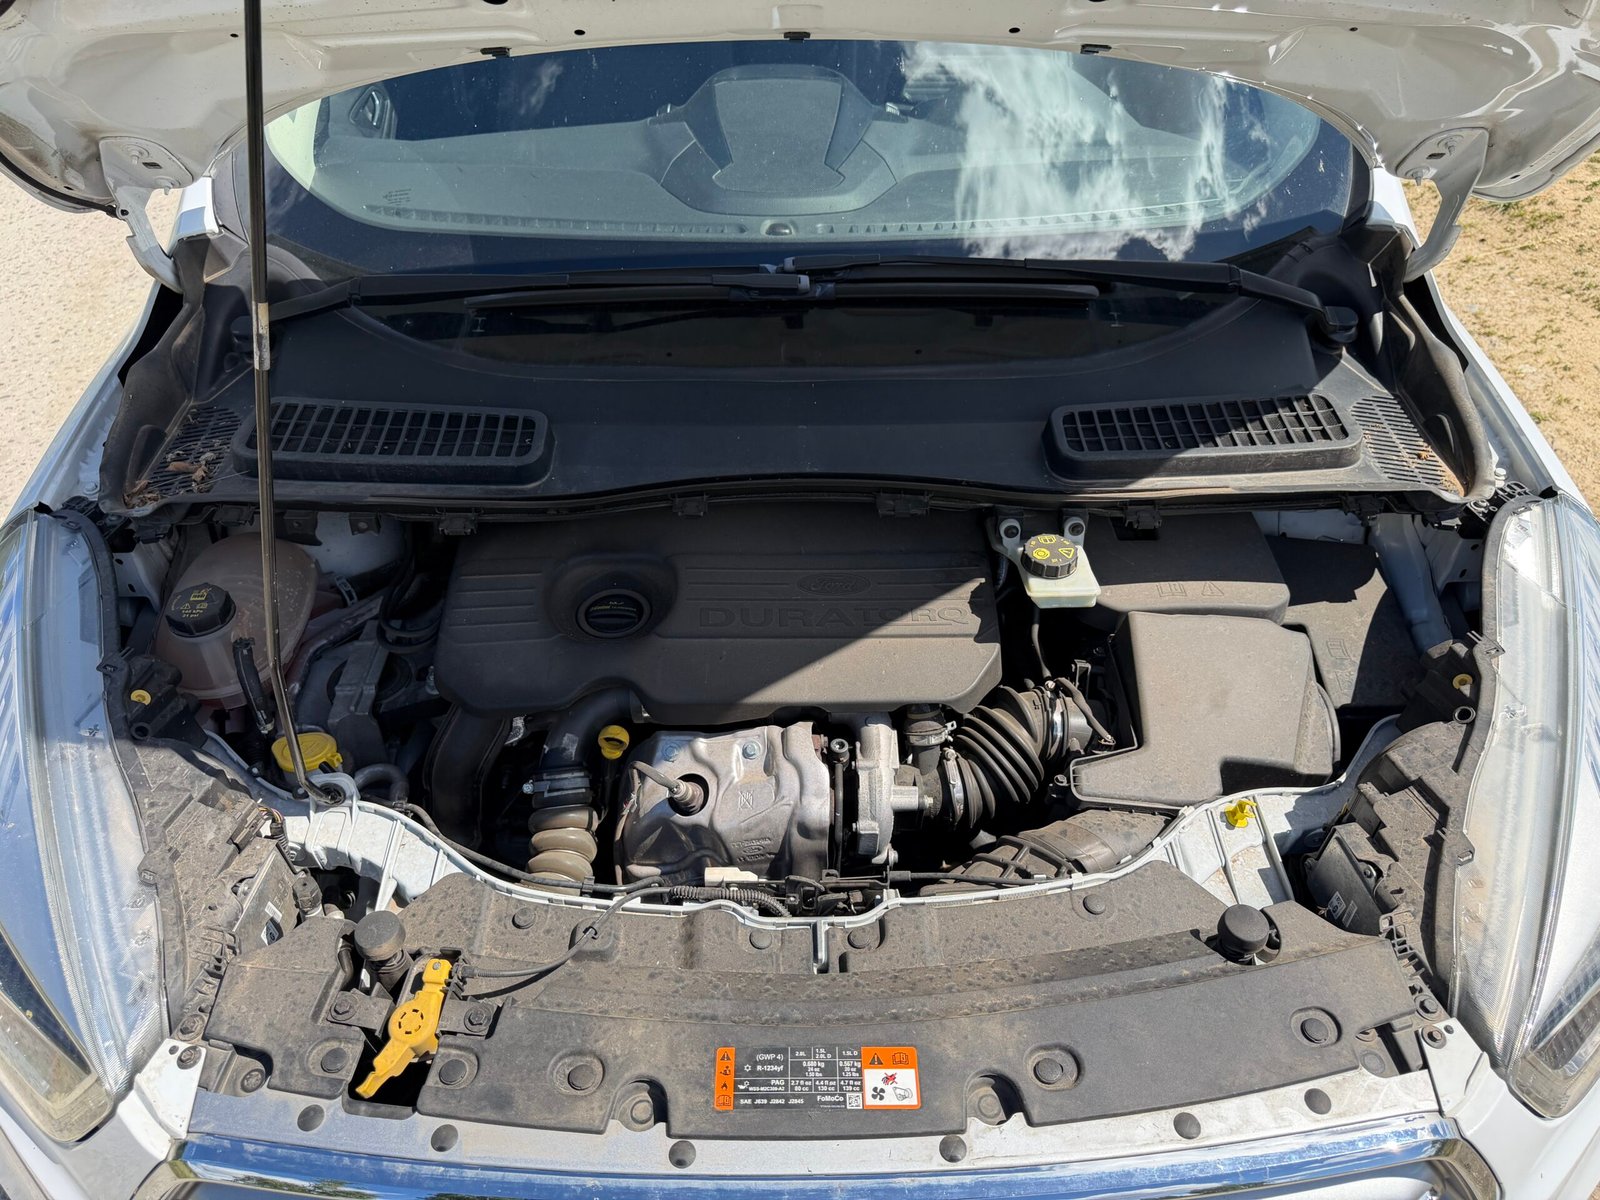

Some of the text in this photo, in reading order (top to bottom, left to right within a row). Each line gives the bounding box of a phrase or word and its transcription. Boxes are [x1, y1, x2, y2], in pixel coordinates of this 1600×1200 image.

[699, 606, 969, 627] DURATORQ
[756, 1053, 784, 1061] (GWP 4)
